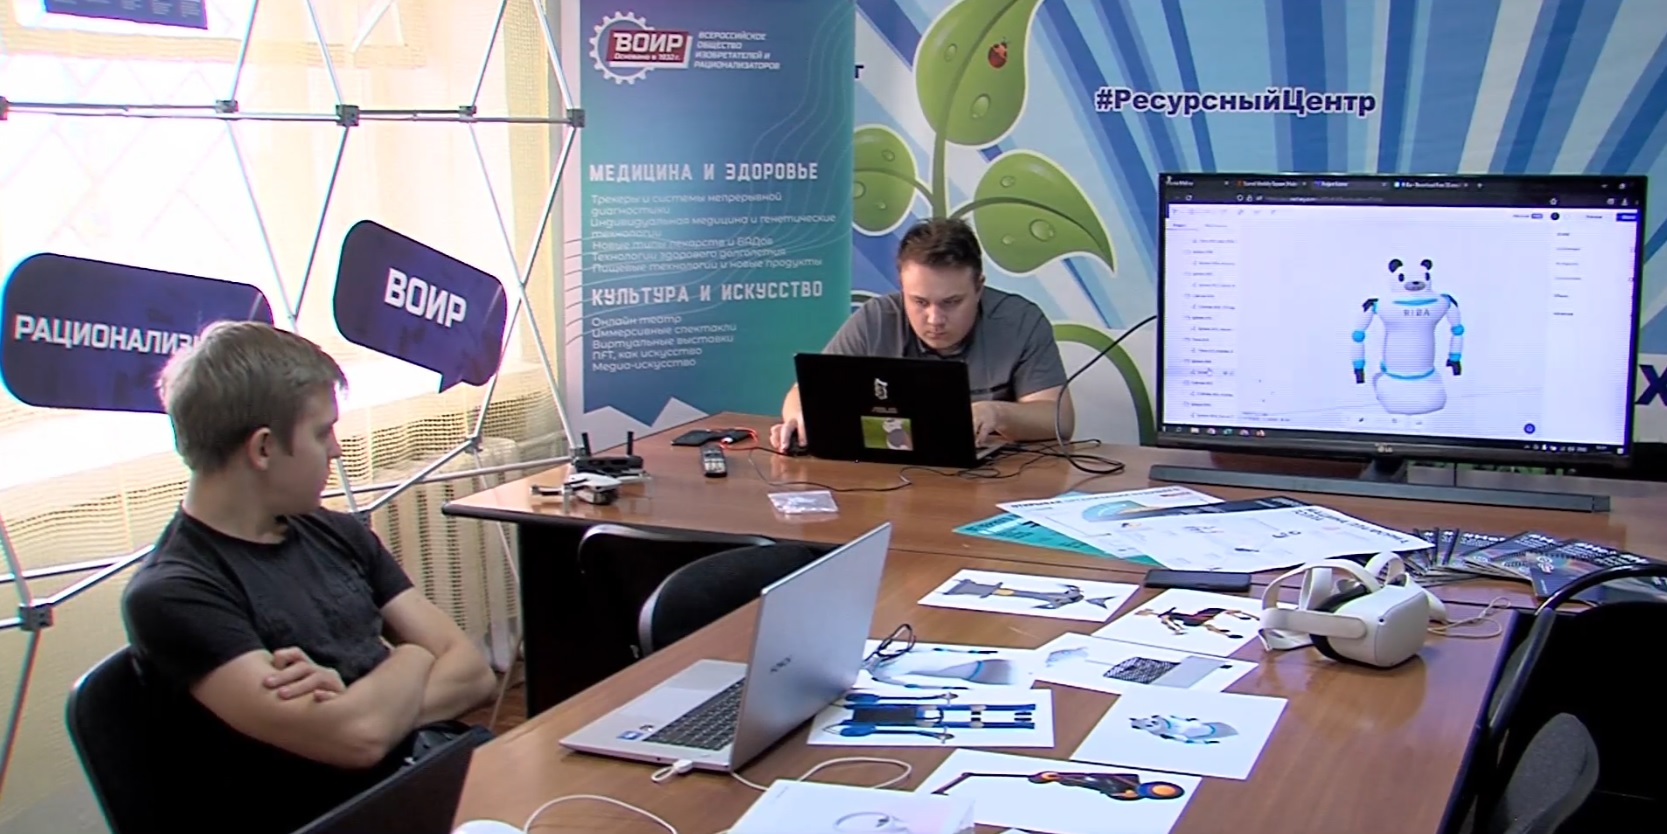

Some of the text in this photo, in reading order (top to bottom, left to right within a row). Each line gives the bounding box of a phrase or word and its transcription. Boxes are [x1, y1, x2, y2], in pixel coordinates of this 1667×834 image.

[612, 32, 684, 53] ВОИР
[698, 31, 767, 41] ВСЕРОССИЙСКОЕ
[697, 41, 743, 50] ОБЩЕСТВО
[695, 51, 763, 60] ИЗОБРЕТАТЕЛЕЙ
[694, 60, 782, 70] РАЦИОНАЛИЗАТОРОВ
[1096, 87, 1377, 117] #РесурсныйЦентр
[589, 162, 819, 183] МЕДИЦИНА И ЗДОРОВЬЕ
[652, 194, 706, 203] системы
[708, 192, 783, 204] непрерывной
[591, 207, 671, 218] диагностики
[590, 217, 690, 229] Индивидуальная
[692, 216, 749, 227] медицина
[760, 214, 837, 224] генетические
[660, 250, 718, 262] здорового
[648, 260, 718, 271] технологии
[730, 260, 764, 269] новые
[765, 258, 823, 269] продукты
[384, 267, 468, 329] ВОИР
[591, 280, 824, 307] КУЛЬТУРА И ИСКУССТВО
[591, 315, 682, 328] Онлайн театр
[13, 313, 203, 356] РАЦИОНАЛИЗ
[591, 324, 737, 339] Иммерсивные спектакли
[592, 335, 735, 350] Виртуальные выставки
[618, 350, 639, 360] как
[640, 347, 703, 359] искусство
[592, 358, 697, 373] Медиа-искусство
